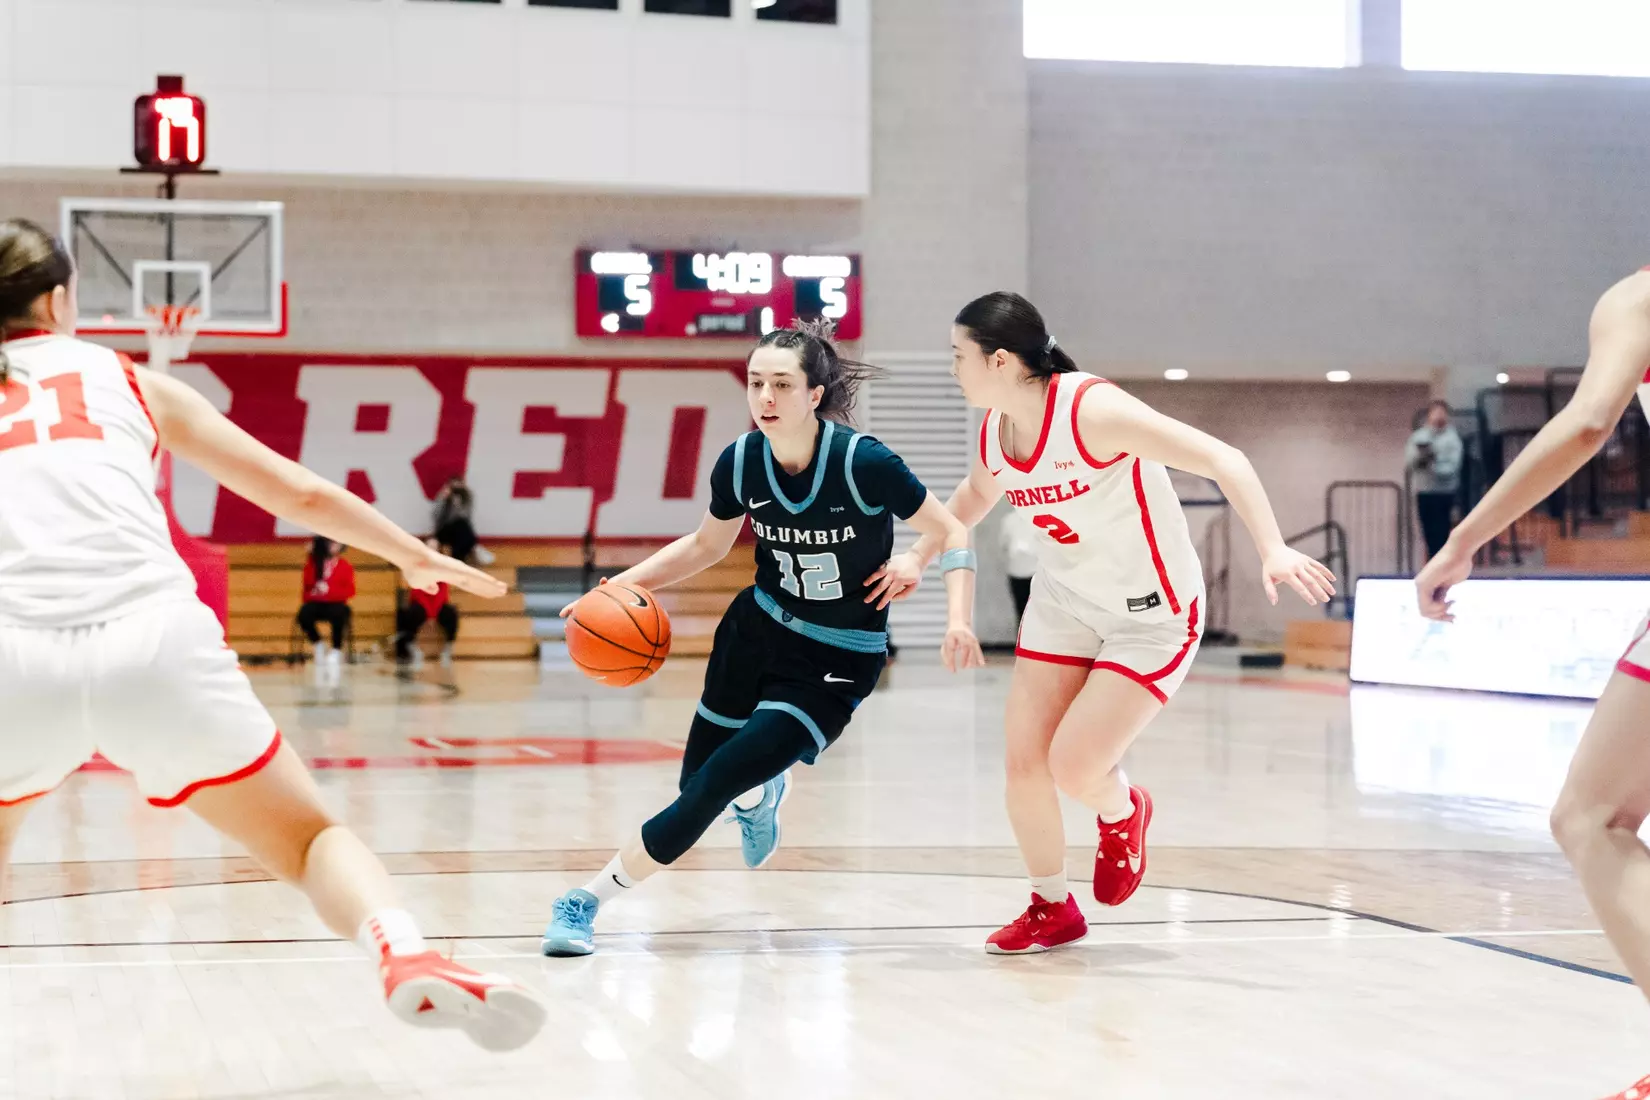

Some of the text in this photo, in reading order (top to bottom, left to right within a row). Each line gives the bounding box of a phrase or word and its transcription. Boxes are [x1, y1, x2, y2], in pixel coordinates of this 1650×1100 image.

[692, 252, 772, 294] 4:09
[624, 274, 651, 316] 5
[820, 277, 847, 318] 5
[0, 372, 104, 451] 21
[275, 364, 750, 537] RED
[1032, 514, 1080, 544] 2
[772, 549, 843, 600] 12
